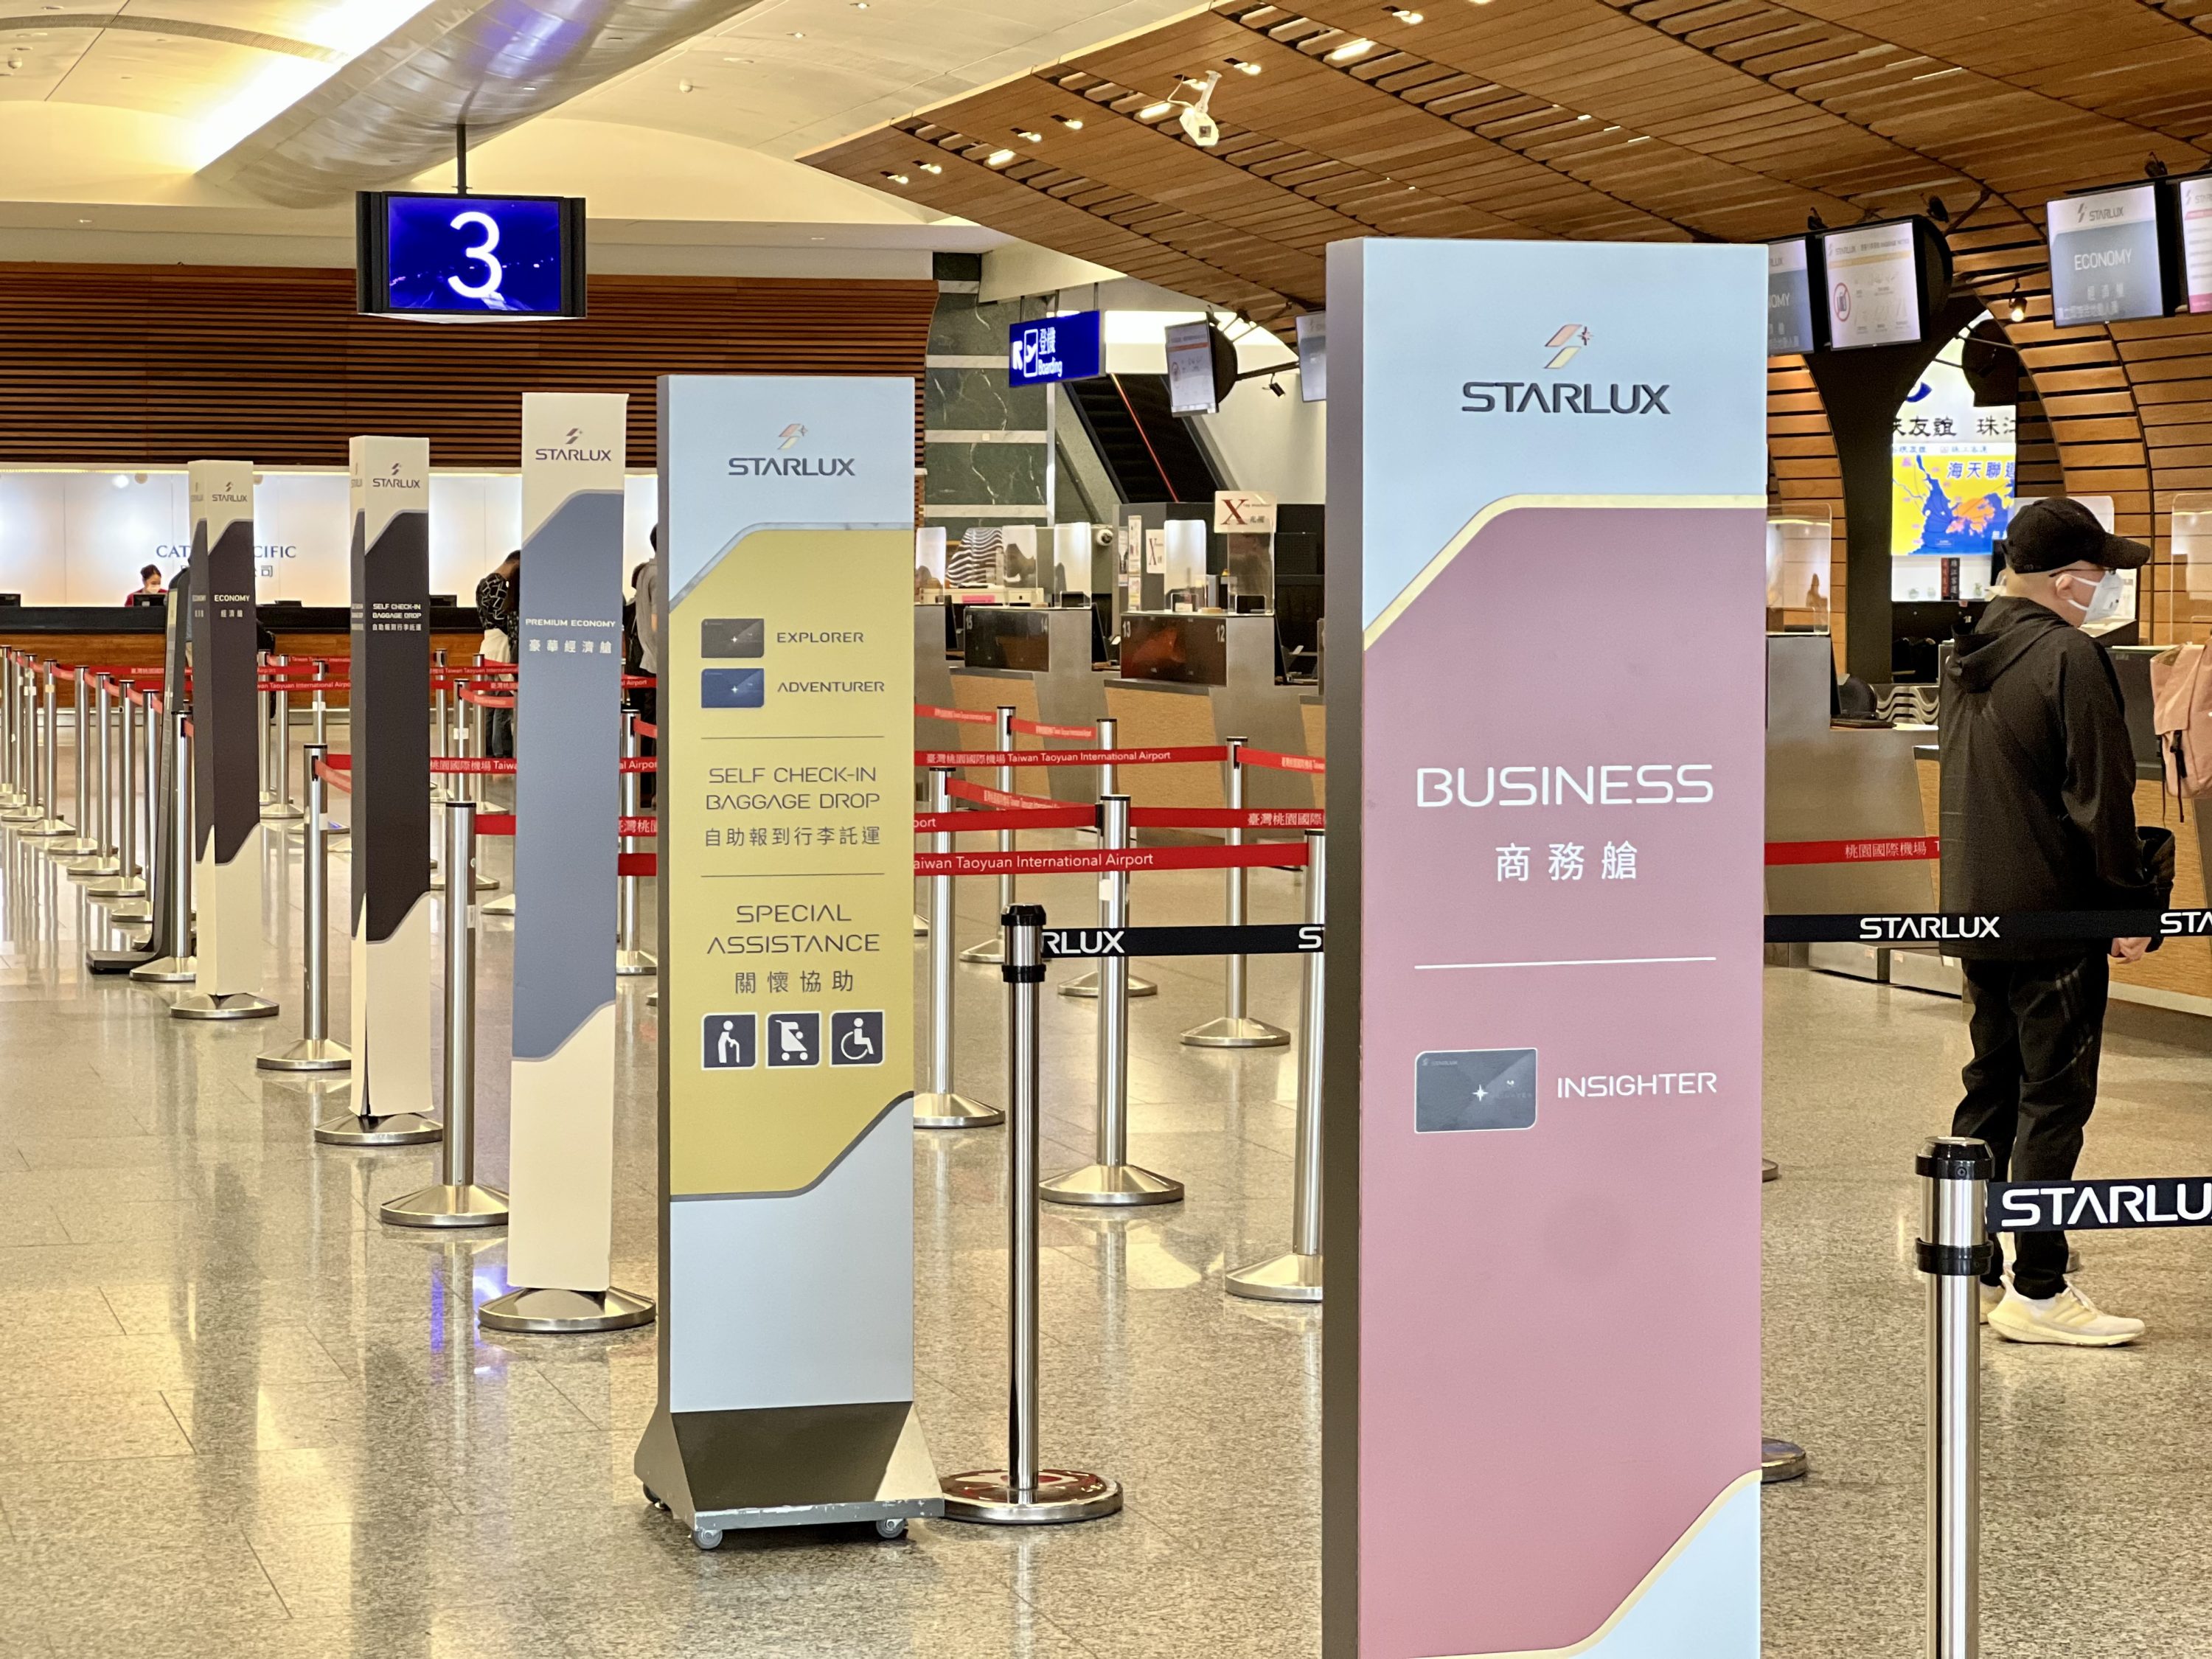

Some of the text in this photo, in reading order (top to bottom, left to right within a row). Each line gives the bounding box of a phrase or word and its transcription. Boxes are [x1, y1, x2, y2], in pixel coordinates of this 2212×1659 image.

[2089, 206, 2124, 221] STARLUX
[448, 211, 503, 299] 3
[2074, 248, 2132, 271] ECONOMY
[1037, 356, 1062, 378] Boarding
[1461, 381, 1672, 414] STARLUX
[535, 448, 611, 462] STARLUX
[728, 457, 855, 476] STARLUX
[372, 478, 420, 488] STARLUX
[212, 494, 248, 502] STARLUX
[1220, 498, 1248, 525] X
[156, 545, 296, 558] CAT CIFIC
[214, 594, 250, 602] ECONOMY
[525, 618, 616, 627] PREMIUM ECONOMY
[1122, 620, 1131, 638] 13
[776, 632, 864, 643] EXPLORER
[1217, 625, 1225, 642] 12
[334, 680, 351, 688] Airpo
[777, 681, 885, 692] ADVENTURER
[493, 760, 516, 770] Taiwa
[628, 759, 657, 772] Airpor
[1008, 753, 1038, 762] Taiwan
[1041, 752, 1078, 764] Taoyuan
[1080, 751, 1137, 761] International
[1139, 750, 1172, 762] Airport
[709, 767, 876, 783] SELF CHECK-IN
[1416, 763, 1714, 807] BUSINESS
[706, 793, 880, 810] BAGGAGE DROP
[1248, 813, 1324, 826] 臺灣桃園國際
[705, 826, 880, 846] 自助報到行李託運
[1845, 841, 1927, 858] 桃園國際機場
[914, 853, 1154, 872] aiwan Taoyuan International Airport
[1495, 840, 1638, 882] 商務艙
[736, 904, 852, 922] SPECIAL
[1859, 917, 2000, 939] STARLUX
[706, 934, 880, 954] ASSISTANCE
[1042, 931, 1125, 954] RLUX
[735, 970, 853, 994] 關懷協助
[1557, 1072, 1717, 1099] INSIGHTER
[2001, 1182, 2212, 1227] STARLU
